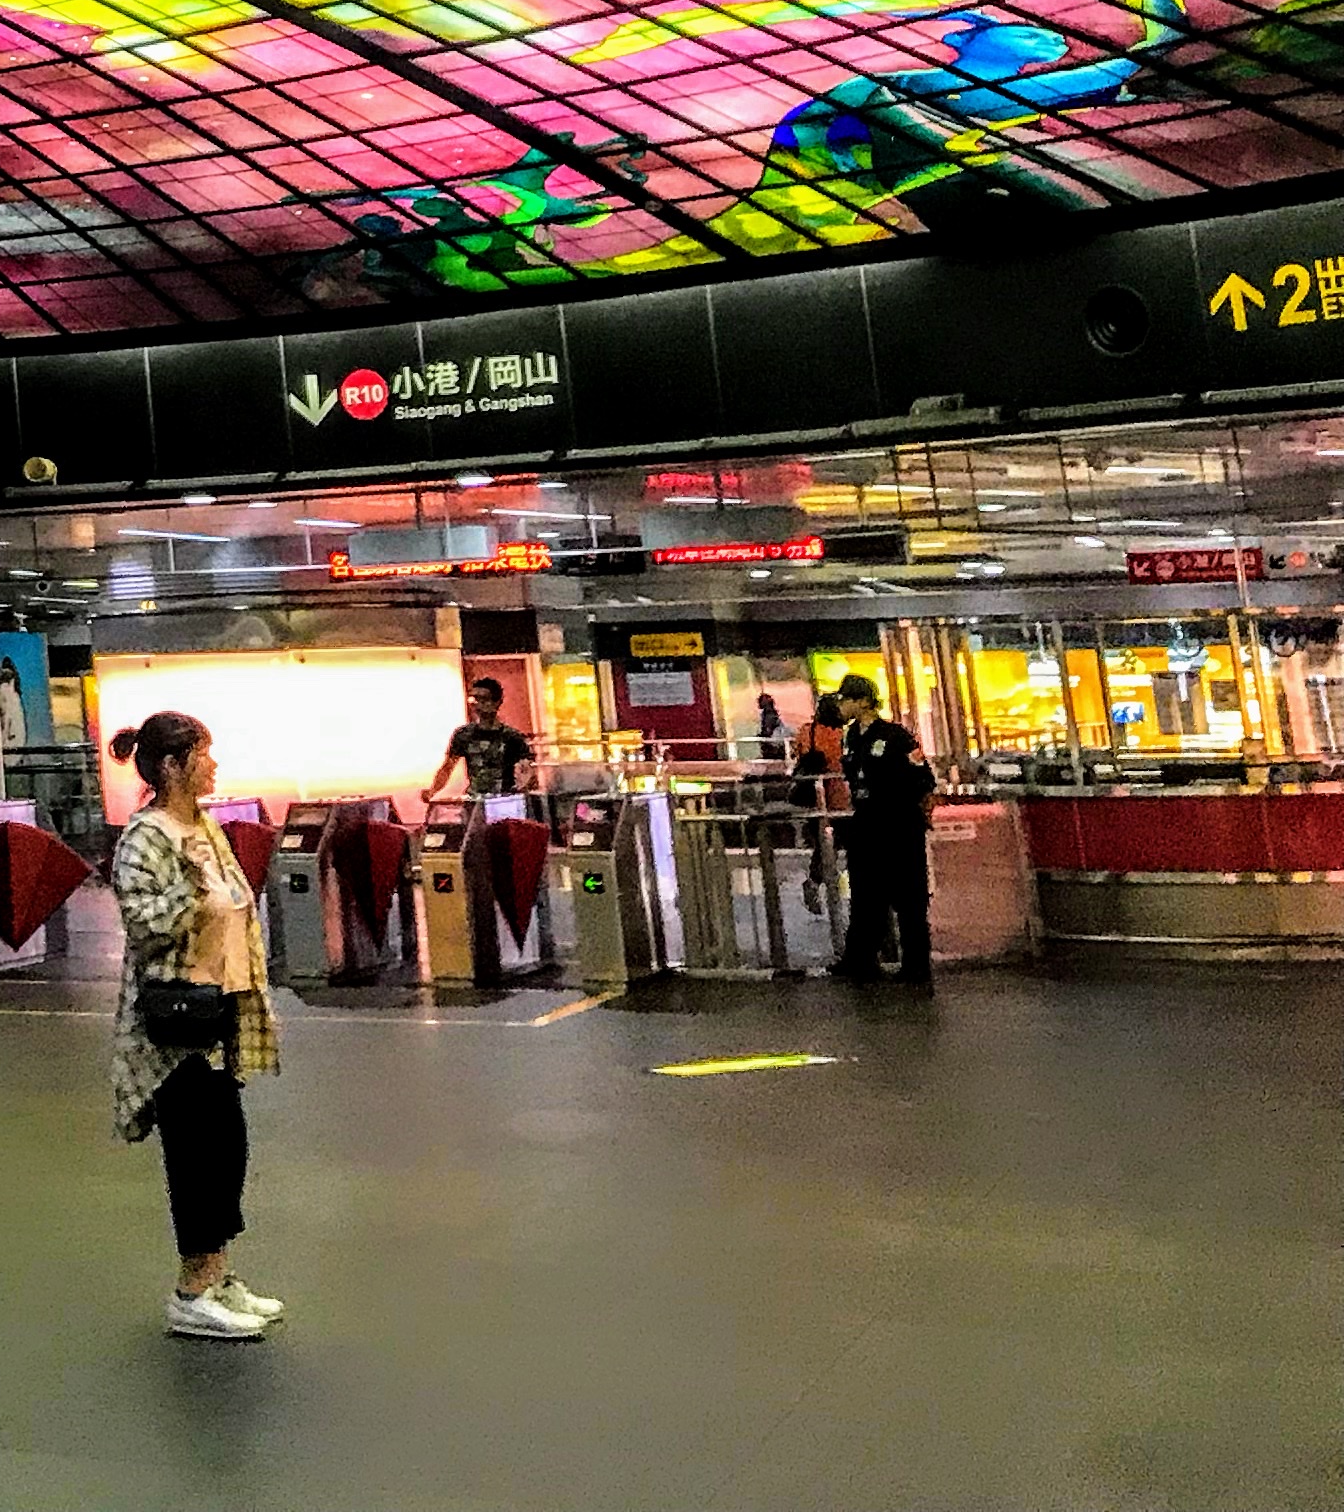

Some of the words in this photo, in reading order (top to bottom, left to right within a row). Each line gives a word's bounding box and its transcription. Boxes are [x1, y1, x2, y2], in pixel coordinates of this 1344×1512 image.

[1273, 263, 1317, 327] 2
[345, 384, 384, 406] R10
[395, 402, 461, 420] Siaogang
[465, 398, 476, 413] &
[480, 392, 554, 412] Gangshan
